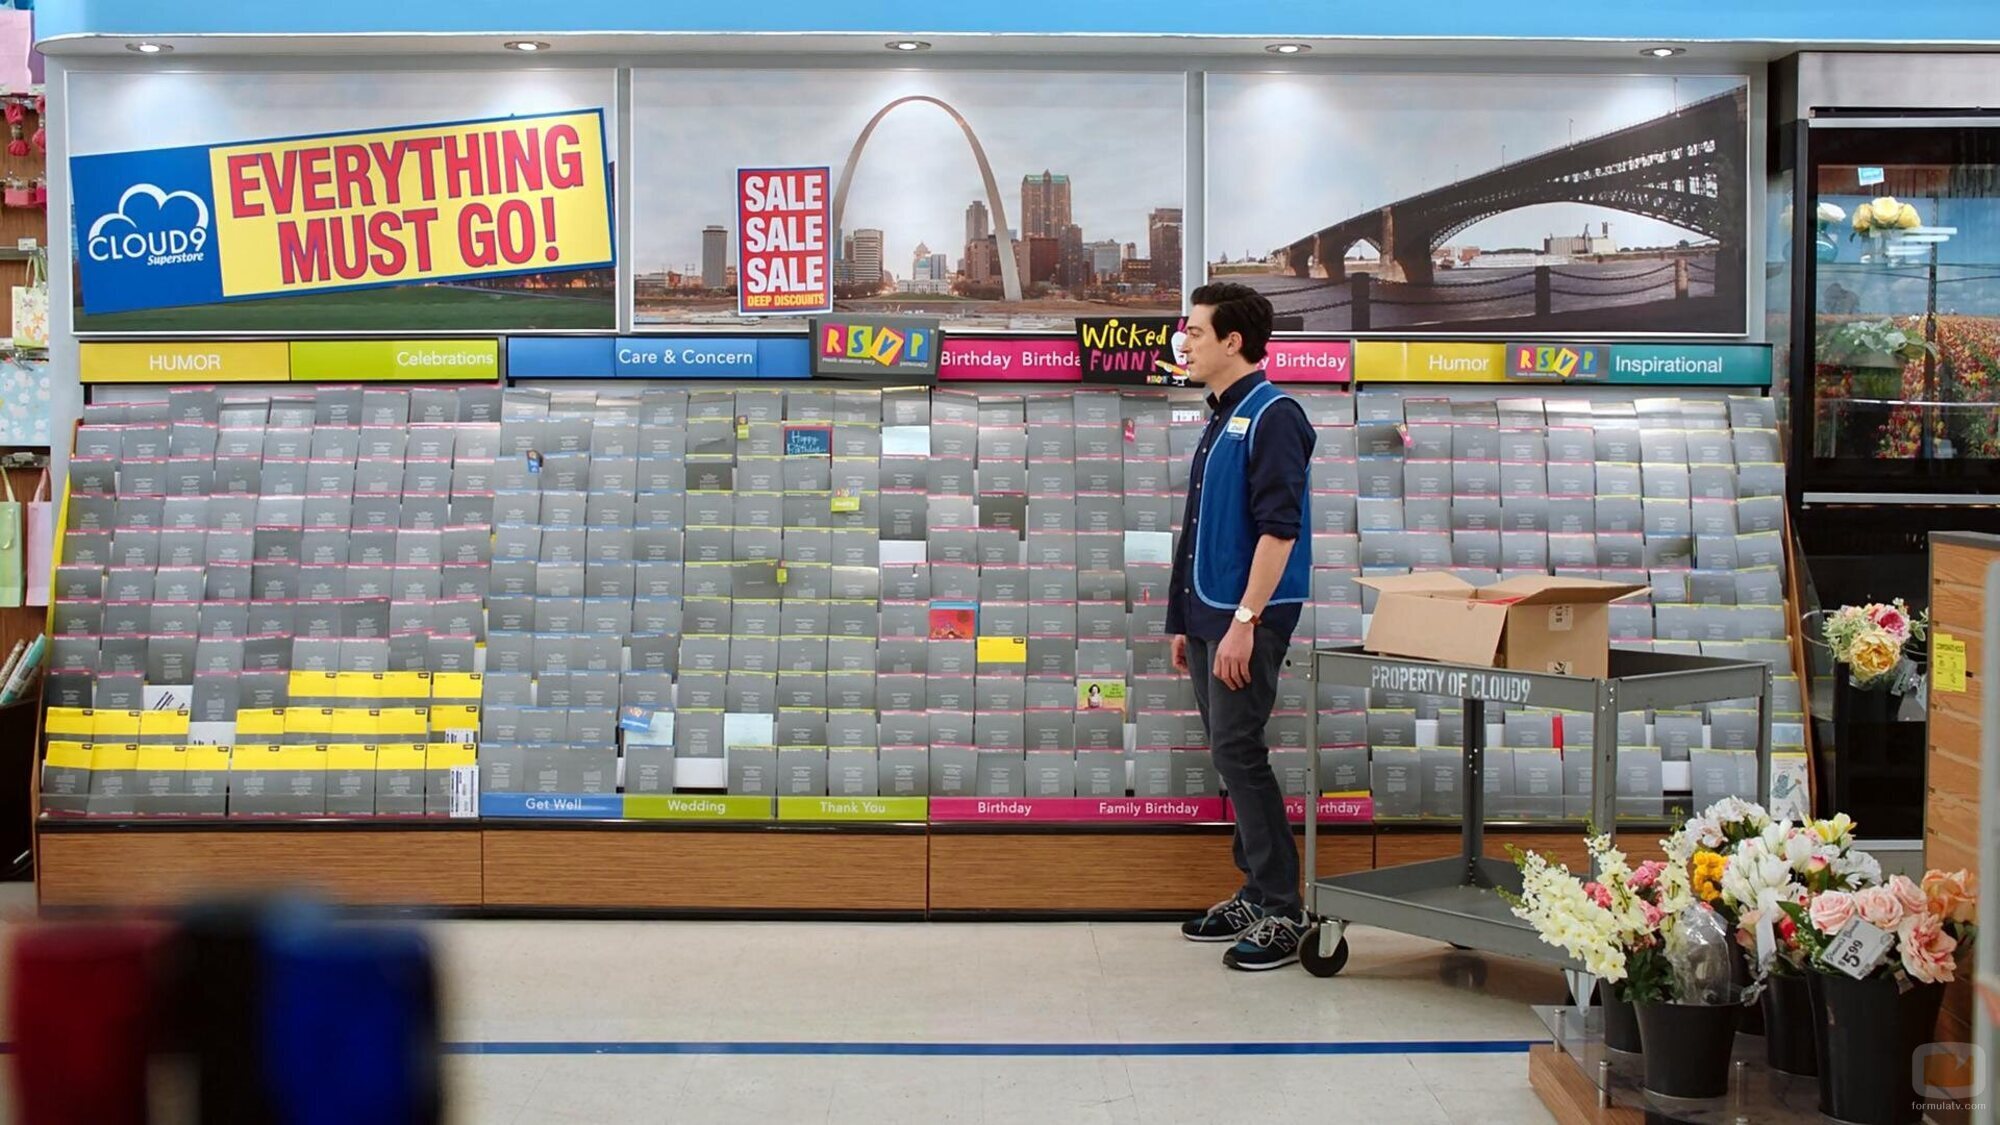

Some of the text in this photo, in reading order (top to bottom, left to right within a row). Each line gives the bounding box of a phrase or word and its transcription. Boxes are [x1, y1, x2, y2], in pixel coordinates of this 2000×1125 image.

[227, 123, 584, 219] EVERYTHING
[745, 175, 823, 212] SALE
[277, 196, 560, 285] MUST GO!
[746, 215, 824, 253] SALE
[88, 227, 207, 261] CLOUD9
[147, 251, 205, 267] Superstore
[747, 256, 824, 294] SALE
[747, 293, 825, 307] DEEP DISCOUNTS
[1082, 319, 1170, 349] Wicked
[150, 354, 221, 371] HUMOR
[396, 350, 494, 367] Celebrations
[618, 349, 753, 365] Care & Concern
[940, 350, 1011, 370] Birthday
[1021, 350, 1081, 366] Birthda
[1090, 349, 1160, 373] FUNNY
[1276, 352, 1346, 371] Birthday
[1428, 355, 1490, 372] Humor
[1615, 355, 1723, 374] Inspirational
[1371, 665, 1532, 703] PROPERTY OF CLOUD9
[525, 798, 582, 810] Get Well
[667, 800, 726, 815] Wedding
[820, 801, 886, 814] Thank You
[978, 801, 1032, 816] Birthday
[1099, 801, 1199, 816] Family Birthday
[1315, 802, 1360, 816] irthday
